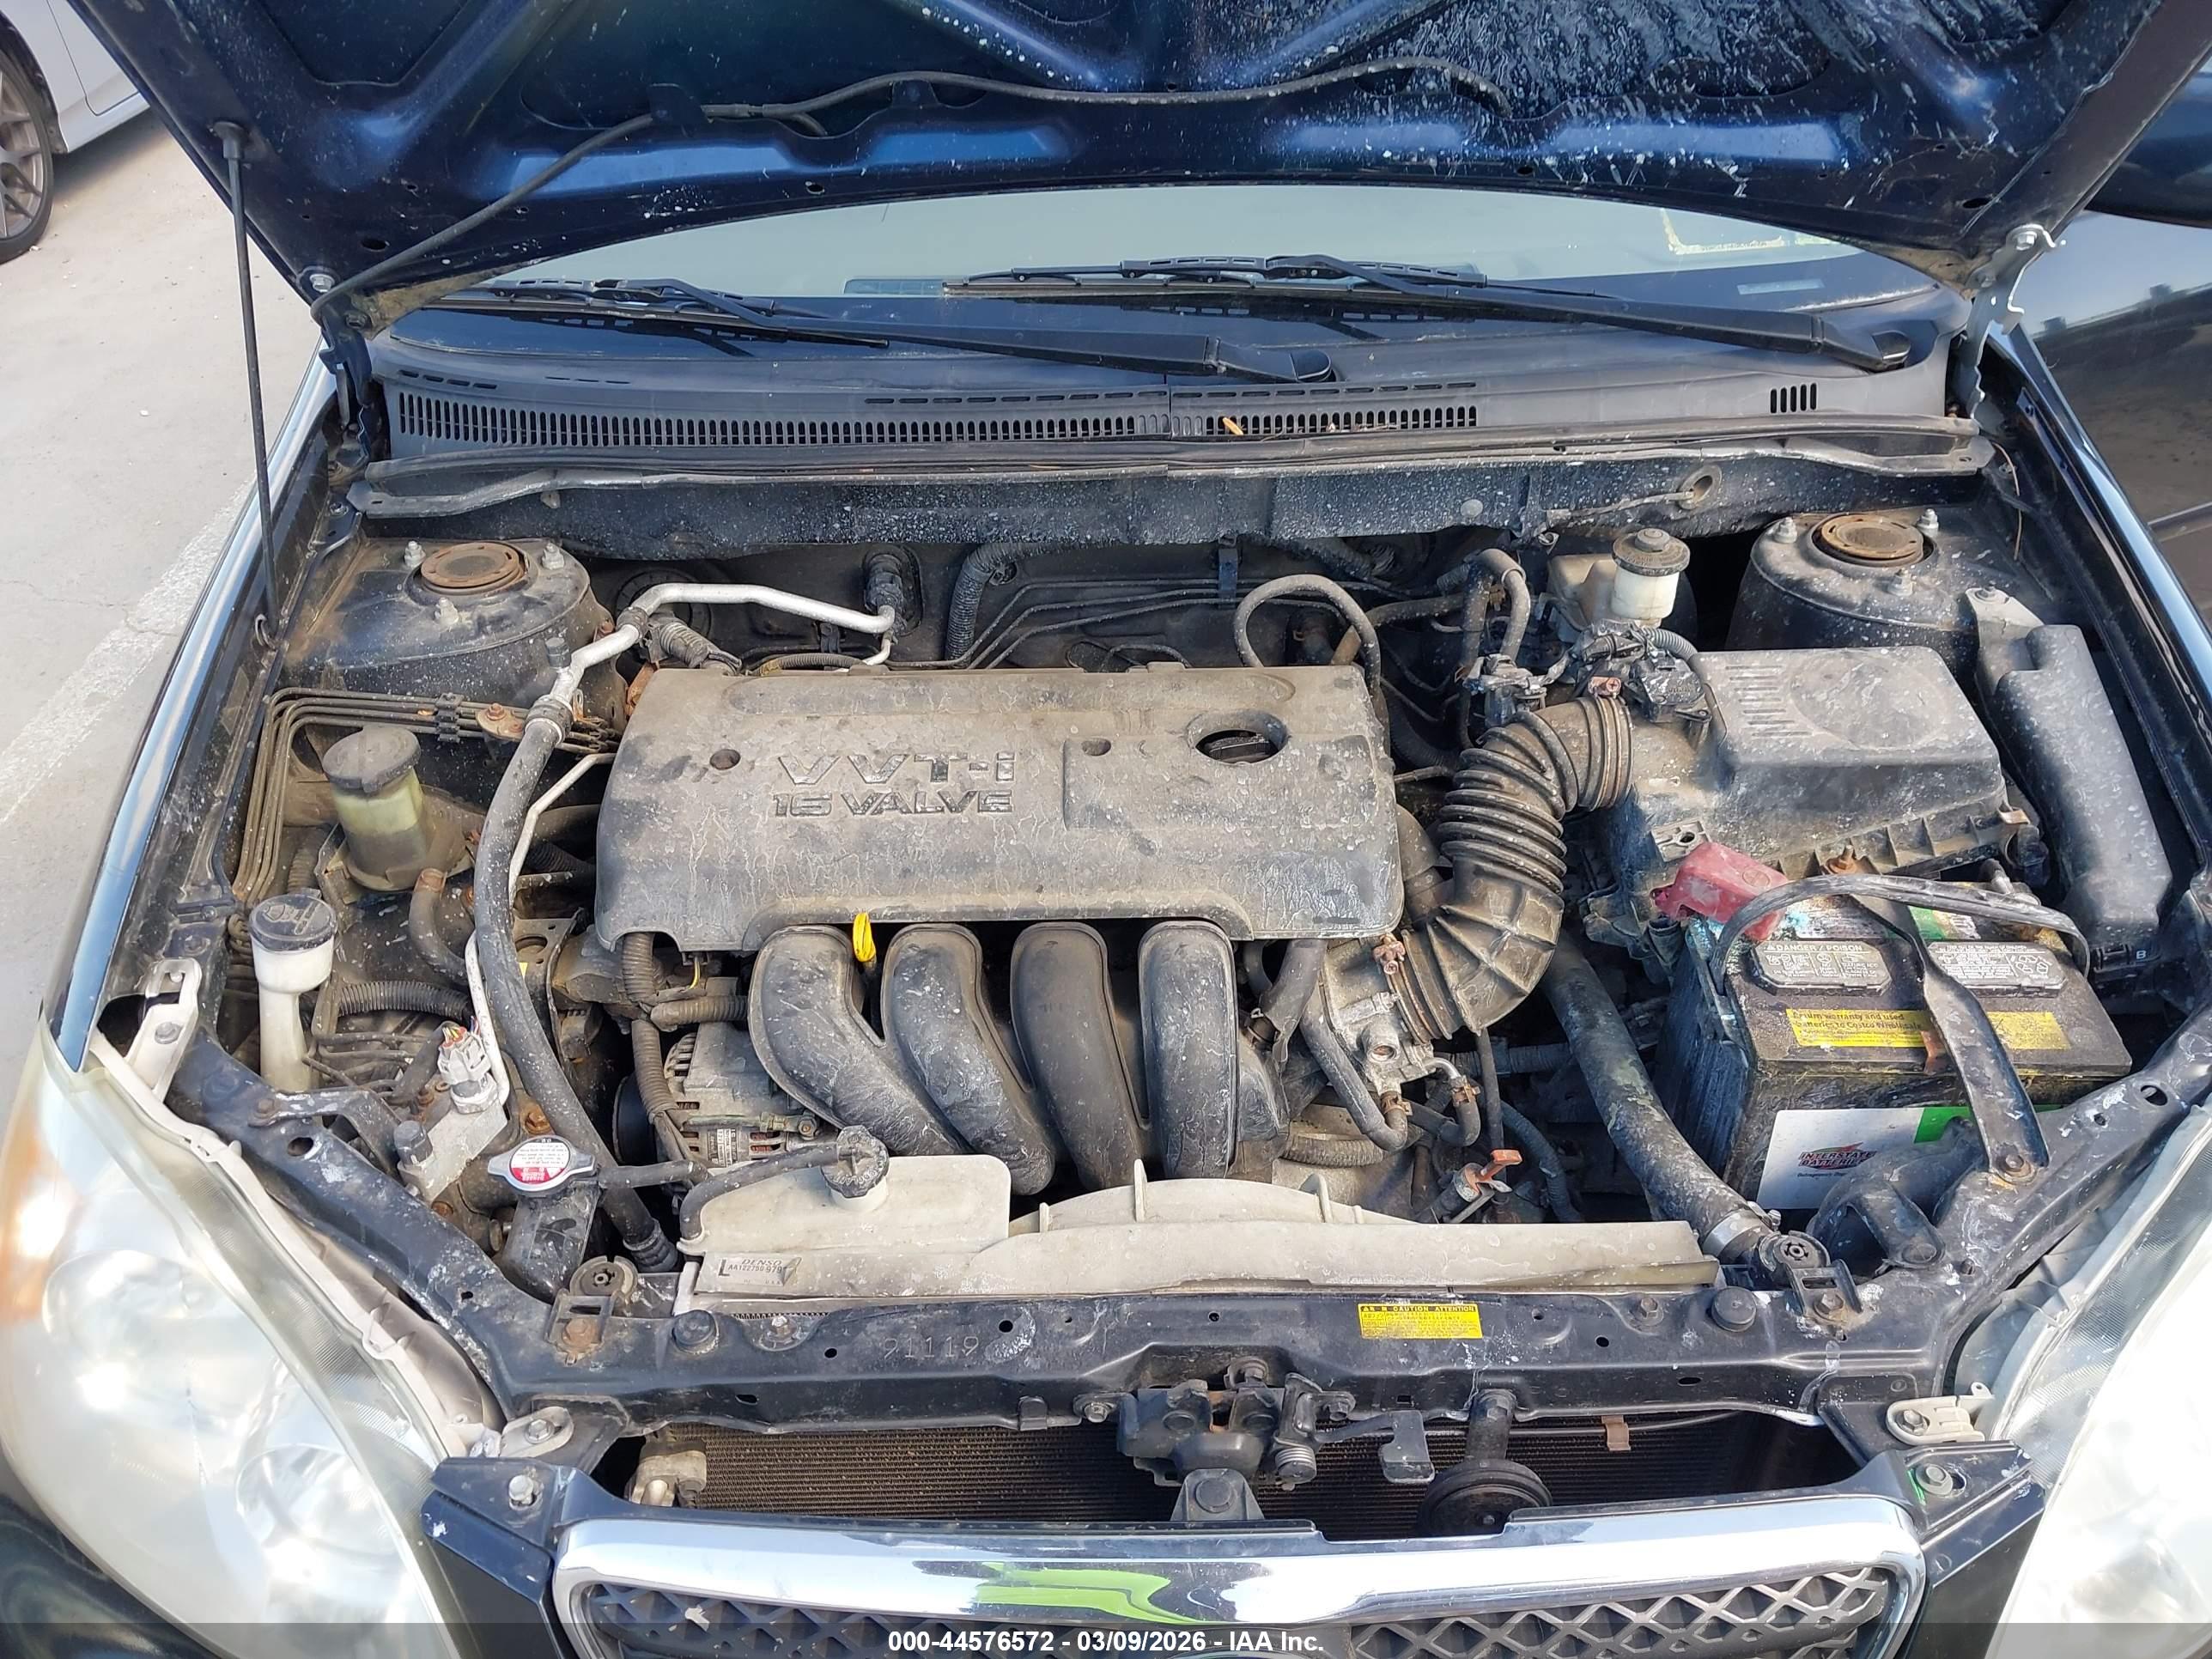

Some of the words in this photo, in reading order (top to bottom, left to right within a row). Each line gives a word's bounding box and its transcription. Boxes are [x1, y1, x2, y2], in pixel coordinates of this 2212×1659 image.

[777, 752, 1015, 785] VVT-i
[774, 792, 833, 816] 16
[841, 790, 1013, 816] VALVE
[2136, 950, 2147, 960] B
[1865, 1012, 1881, 1020] and
[1882, 1012, 1905, 1020] used
[1846, 1021, 1875, 1030] Costco
[1799, 1151, 1875, 1160] INTERSTATE
[718, 1259, 730, 1276] L
